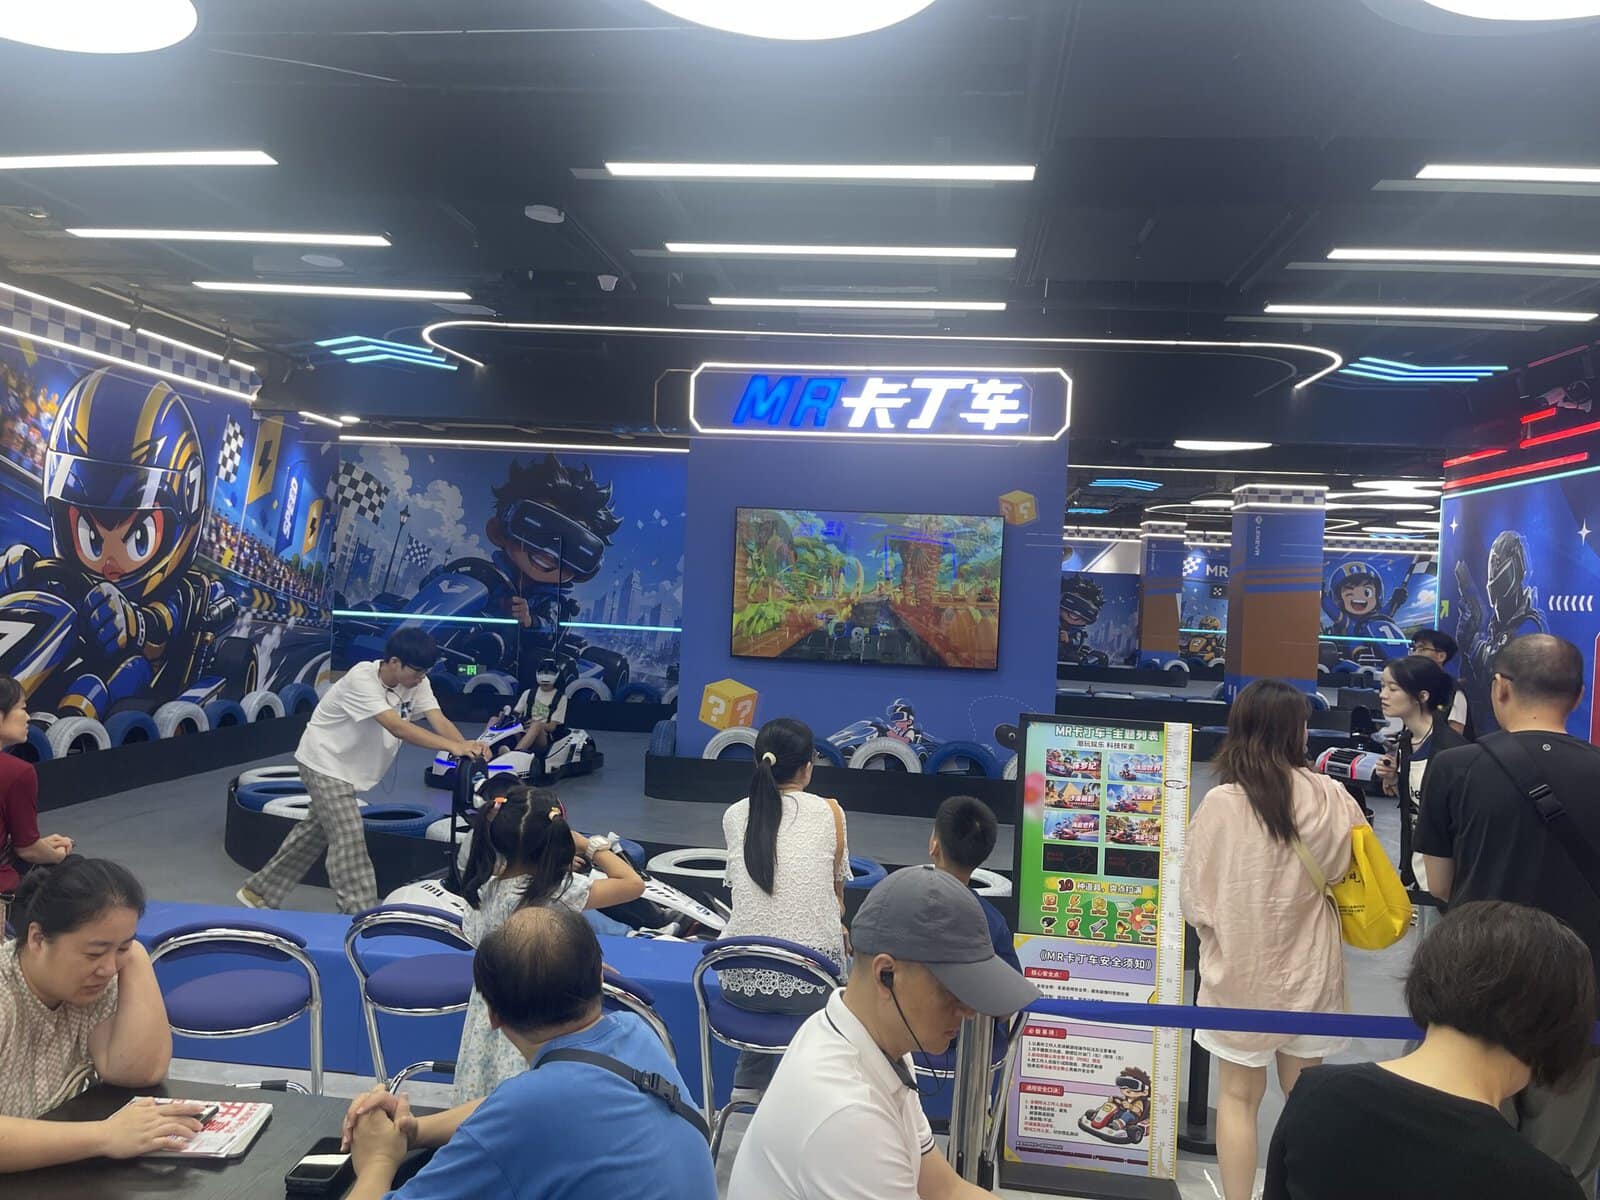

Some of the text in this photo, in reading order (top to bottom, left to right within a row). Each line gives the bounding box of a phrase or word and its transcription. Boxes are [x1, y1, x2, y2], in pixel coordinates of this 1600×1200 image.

[732, 375, 1029, 430] MR卡丁车
[282, 476, 298, 540] SPEED
